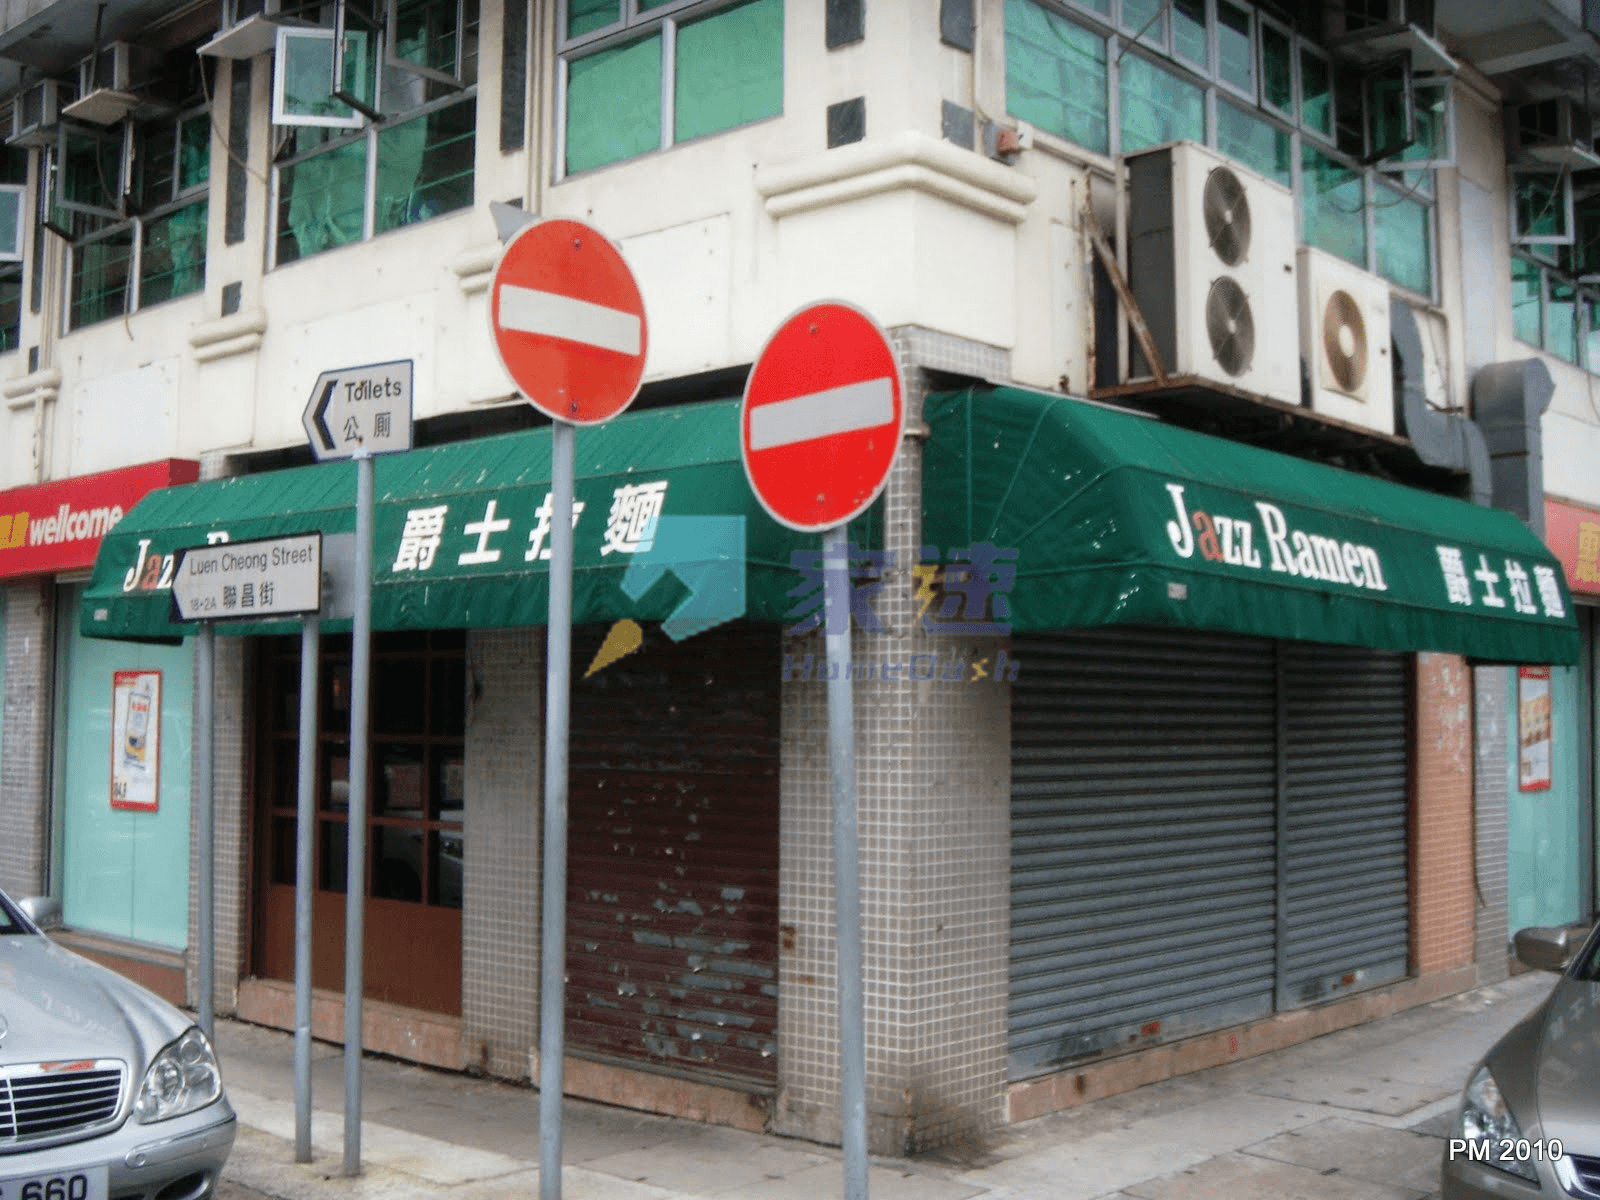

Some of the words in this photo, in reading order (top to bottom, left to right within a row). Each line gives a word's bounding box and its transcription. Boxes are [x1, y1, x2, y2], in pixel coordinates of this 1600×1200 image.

[344, 376, 402, 402] Toilets
[29, 503, 124, 546] wellcome
[1166, 483, 1262, 569] Jazz
[1255, 501, 1388, 591] Ramen
[123, 539, 174, 592] Jaz
[190, 558, 218, 576] Luen
[221, 552, 267, 572] Cheong
[272, 544, 313, 566] Street
[223, 581, 275, 609] 聯昌街
[21, 1174, 88, 1200] 660
